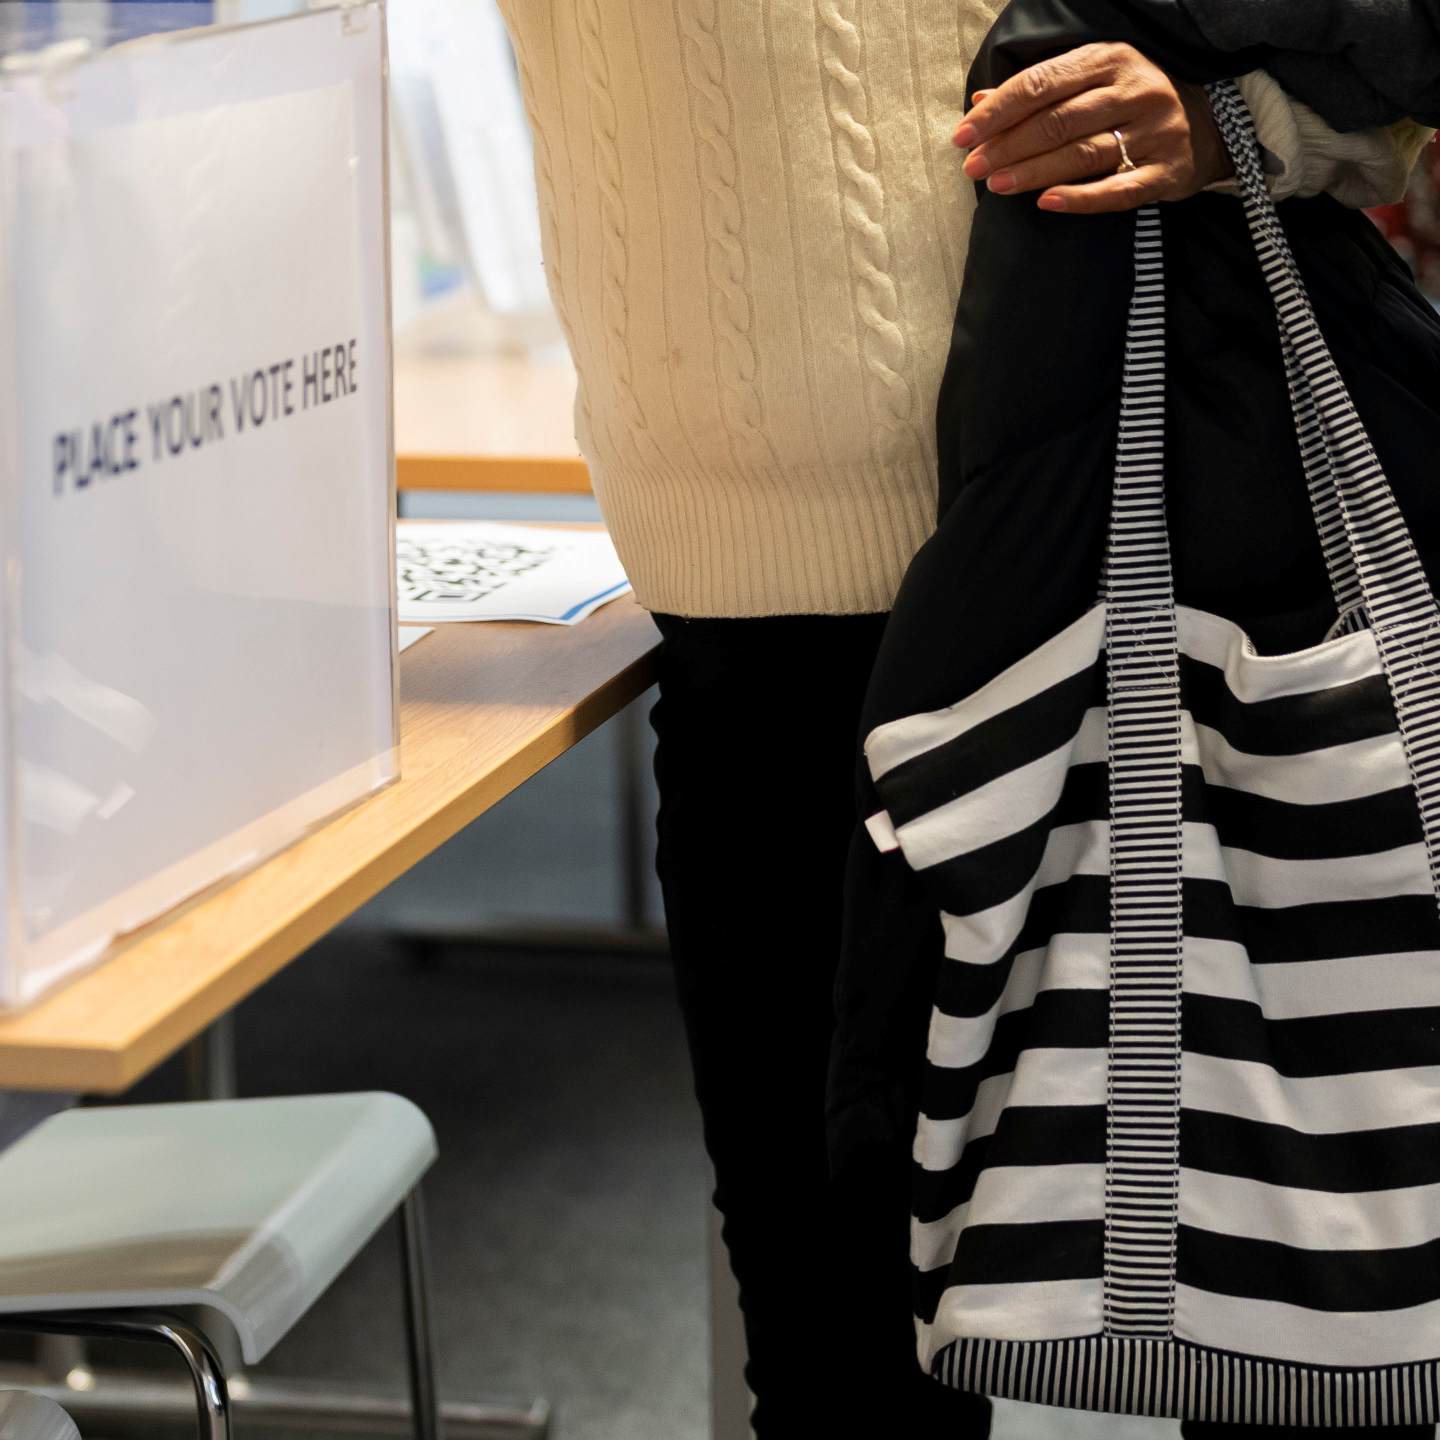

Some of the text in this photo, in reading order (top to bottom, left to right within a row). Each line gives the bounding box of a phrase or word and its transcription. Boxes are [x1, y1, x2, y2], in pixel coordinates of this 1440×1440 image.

[52, 339, 358, 495] PLACE YOUR VOTE HERE
